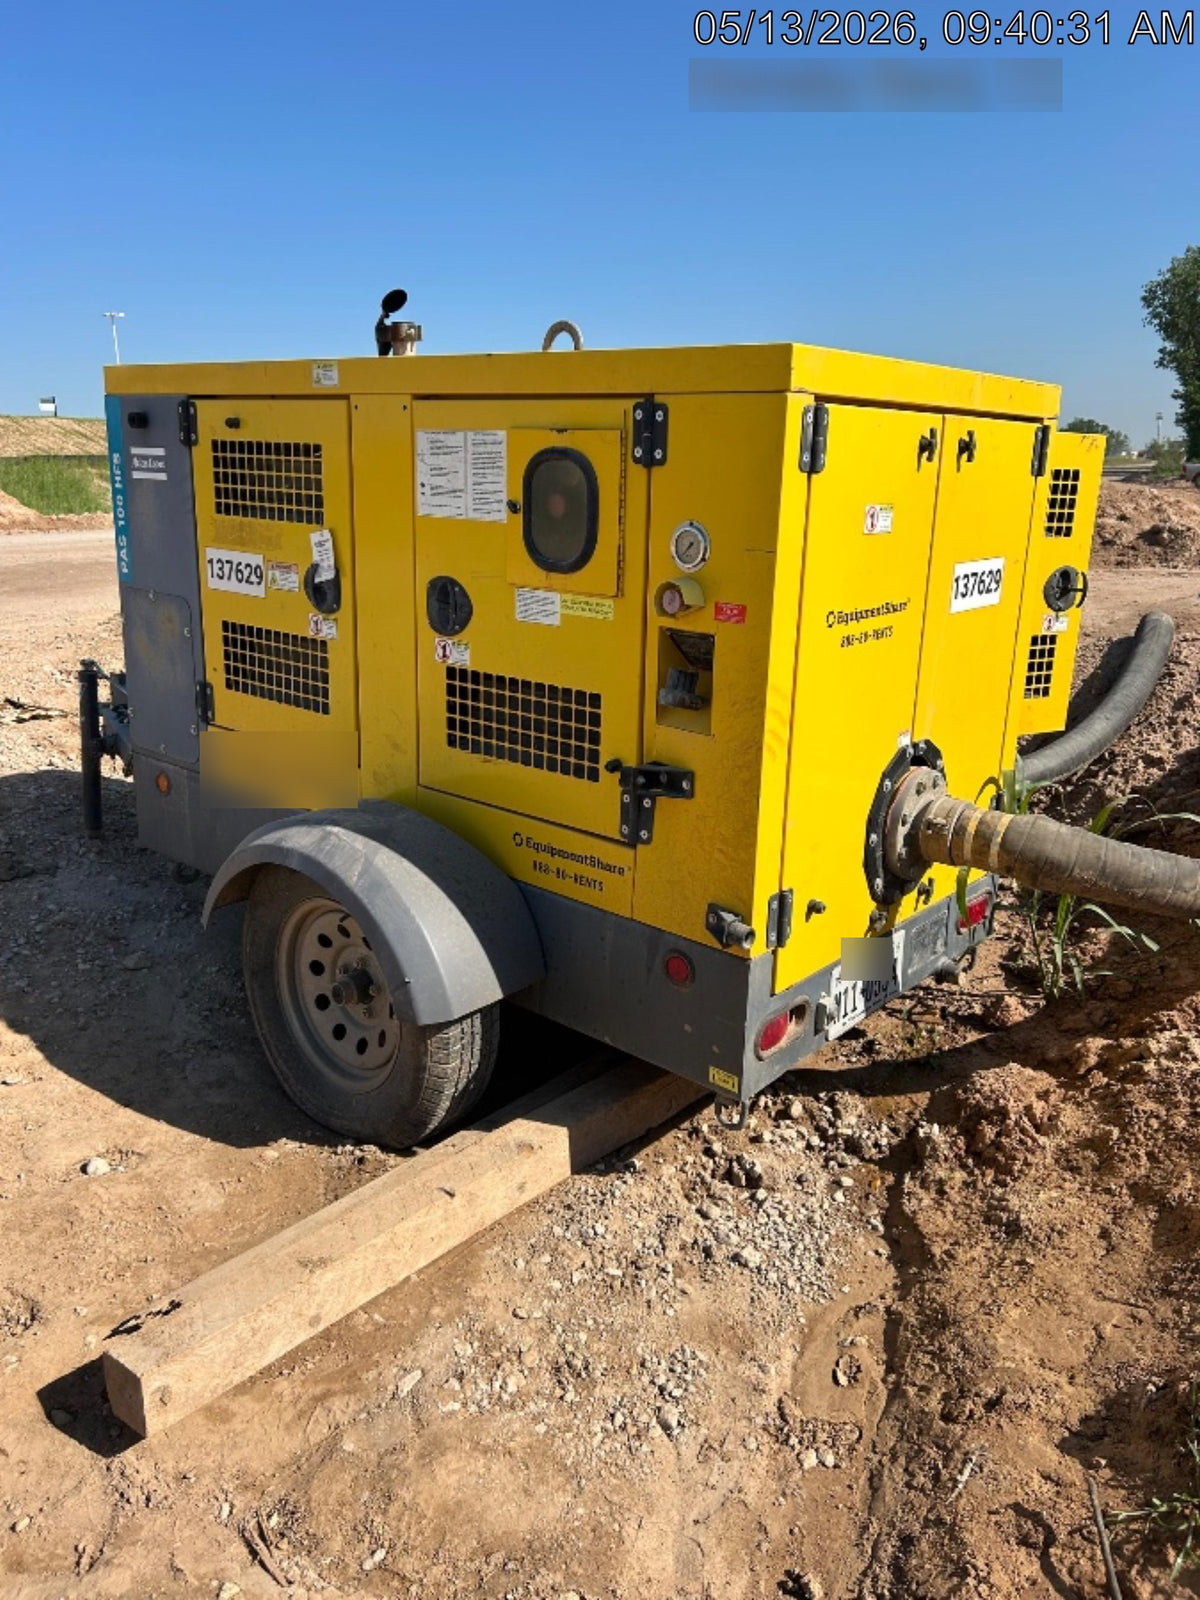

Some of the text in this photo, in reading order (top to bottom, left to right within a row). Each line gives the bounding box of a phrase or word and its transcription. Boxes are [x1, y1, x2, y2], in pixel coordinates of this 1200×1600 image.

[116, 496, 126, 527] 100
[118, 535, 129, 574] PAS
[207, 557, 264, 586] 137629
[953, 568, 1003, 600] 137629
[525, 836, 625, 877] EquipmentShare
